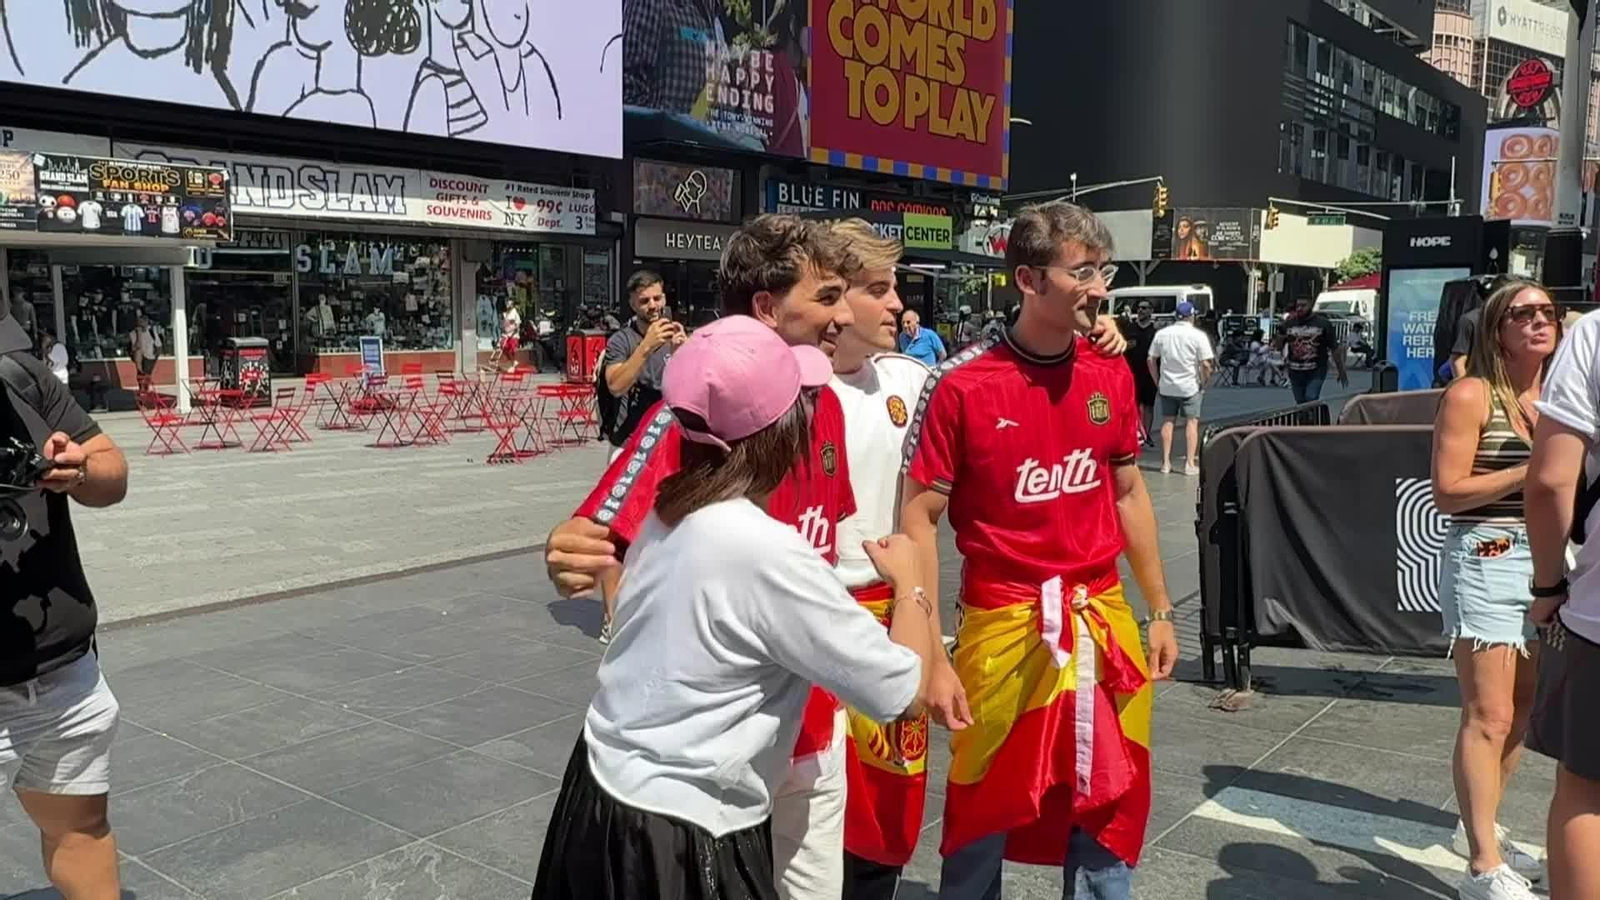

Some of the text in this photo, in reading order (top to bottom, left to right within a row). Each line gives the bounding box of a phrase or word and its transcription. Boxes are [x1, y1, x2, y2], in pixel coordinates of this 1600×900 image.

[1510, 14, 1539, 34] HYATT
[827, 0, 967, 88] COMES
[706, 40, 775, 73] MAYBE
[706, 61, 775, 93] HAPPY
[706, 82, 775, 114] ENDING
[844, 58, 996, 146] TO PLAY
[89, 163, 181, 186] SPORTS
[102, 180, 130, 190] FAN
[133, 182, 170, 192] SHOP
[299, 164, 407, 215] SLAM
[429, 178, 490, 193] DISCOUNT
[517, 184, 539, 195] Rated
[540, 187, 571, 198] Souvenir
[571, 190, 591, 201] Shop
[435, 192, 480, 206] GIFTS &
[778, 182, 861, 209] BLUE FIN
[426, 204, 493, 221] SOUVENIRS
[503, 211, 528, 228] NY
[537, 217, 563, 230] Dept.
[574, 215, 584, 230] 3
[666, 232, 722, 251] HEYTEA
[905, 225, 952, 243] CENTER
[1409, 235, 1452, 248] HOPE
[1402, 322, 1437, 335] WAT
[1014, 447, 1101, 503] tenth
